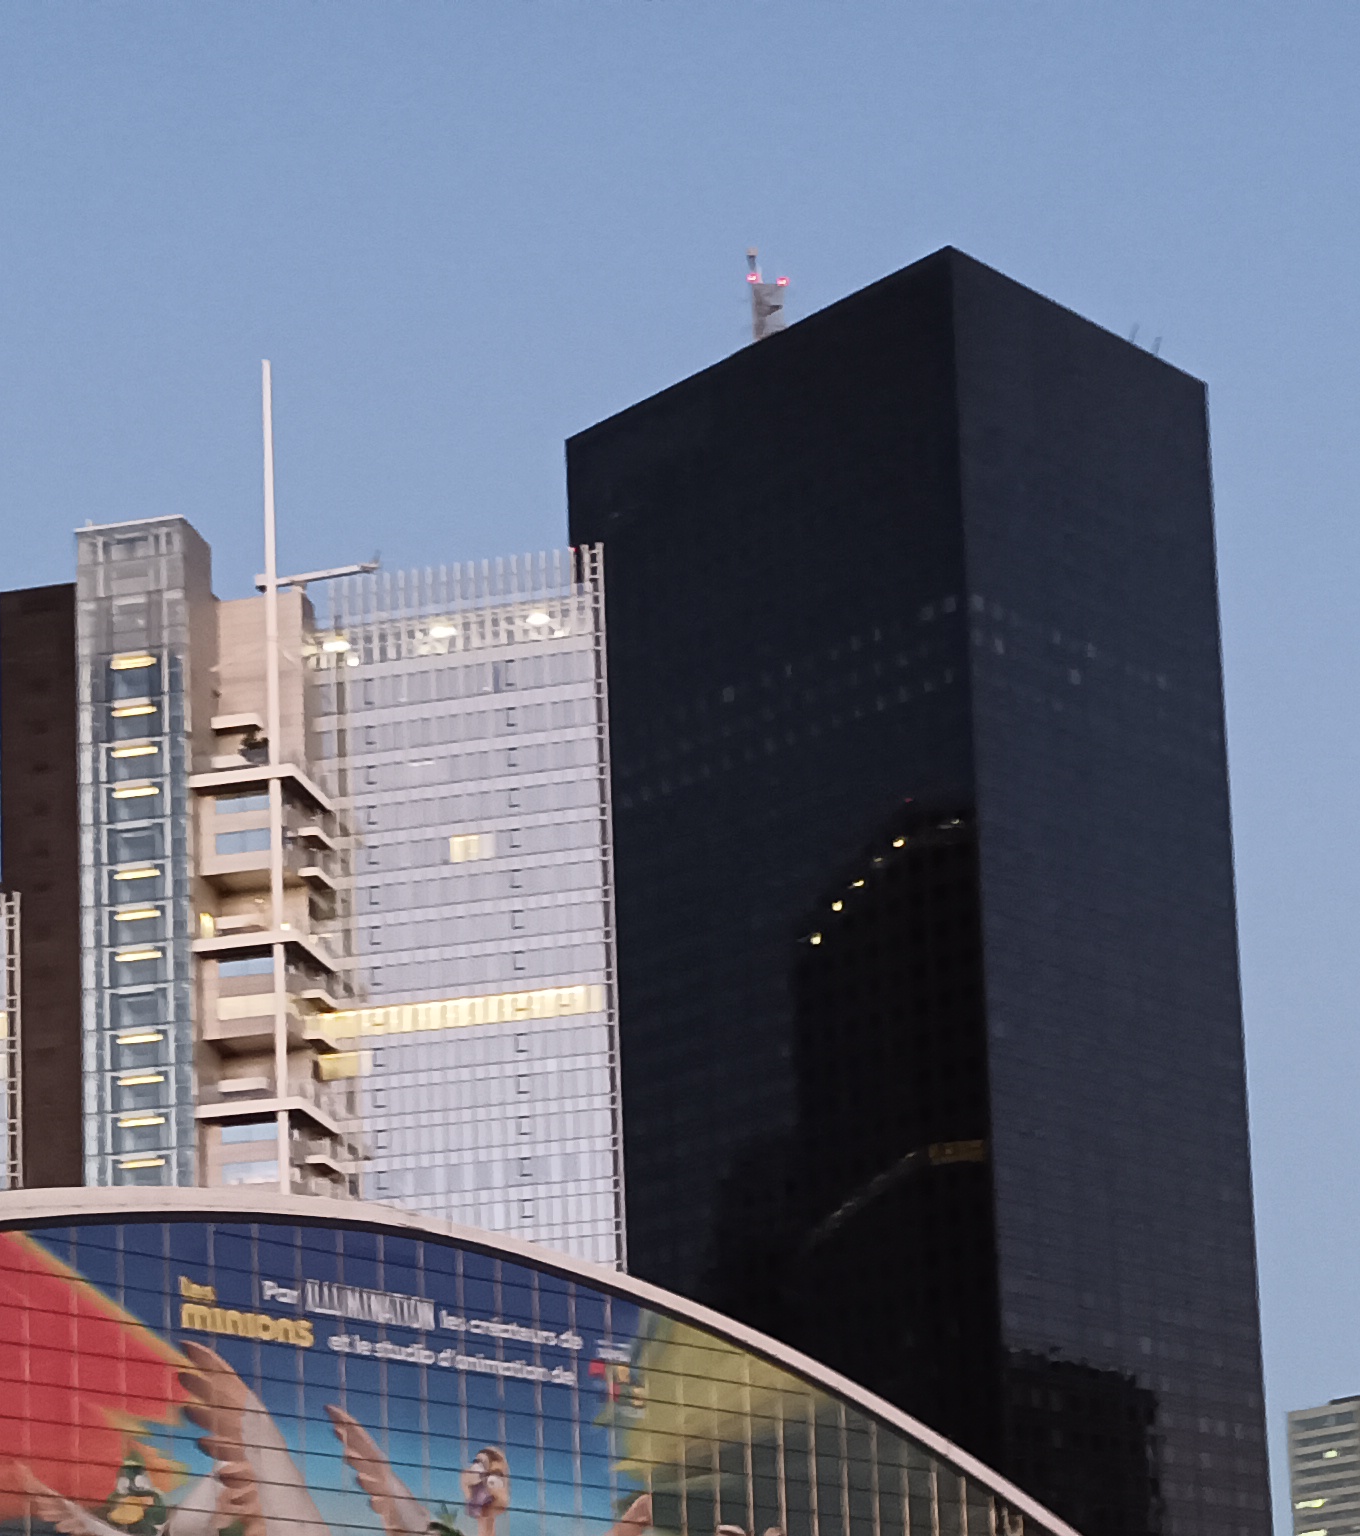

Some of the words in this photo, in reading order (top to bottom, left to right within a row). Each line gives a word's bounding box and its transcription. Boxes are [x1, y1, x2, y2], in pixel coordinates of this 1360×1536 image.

[180, 1303, 315, 1348] minions
[261, 1279, 302, 1305] Par
[439, 1309, 467, 1332] les
[558, 1329, 584, 1350] de
[327, 1333, 350, 1352] et
[353, 1334, 373, 1355] le
[374, 1341, 436, 1365] studio
[437, 1348, 551, 1382] d'animation
[551, 1365, 577, 1386] de
